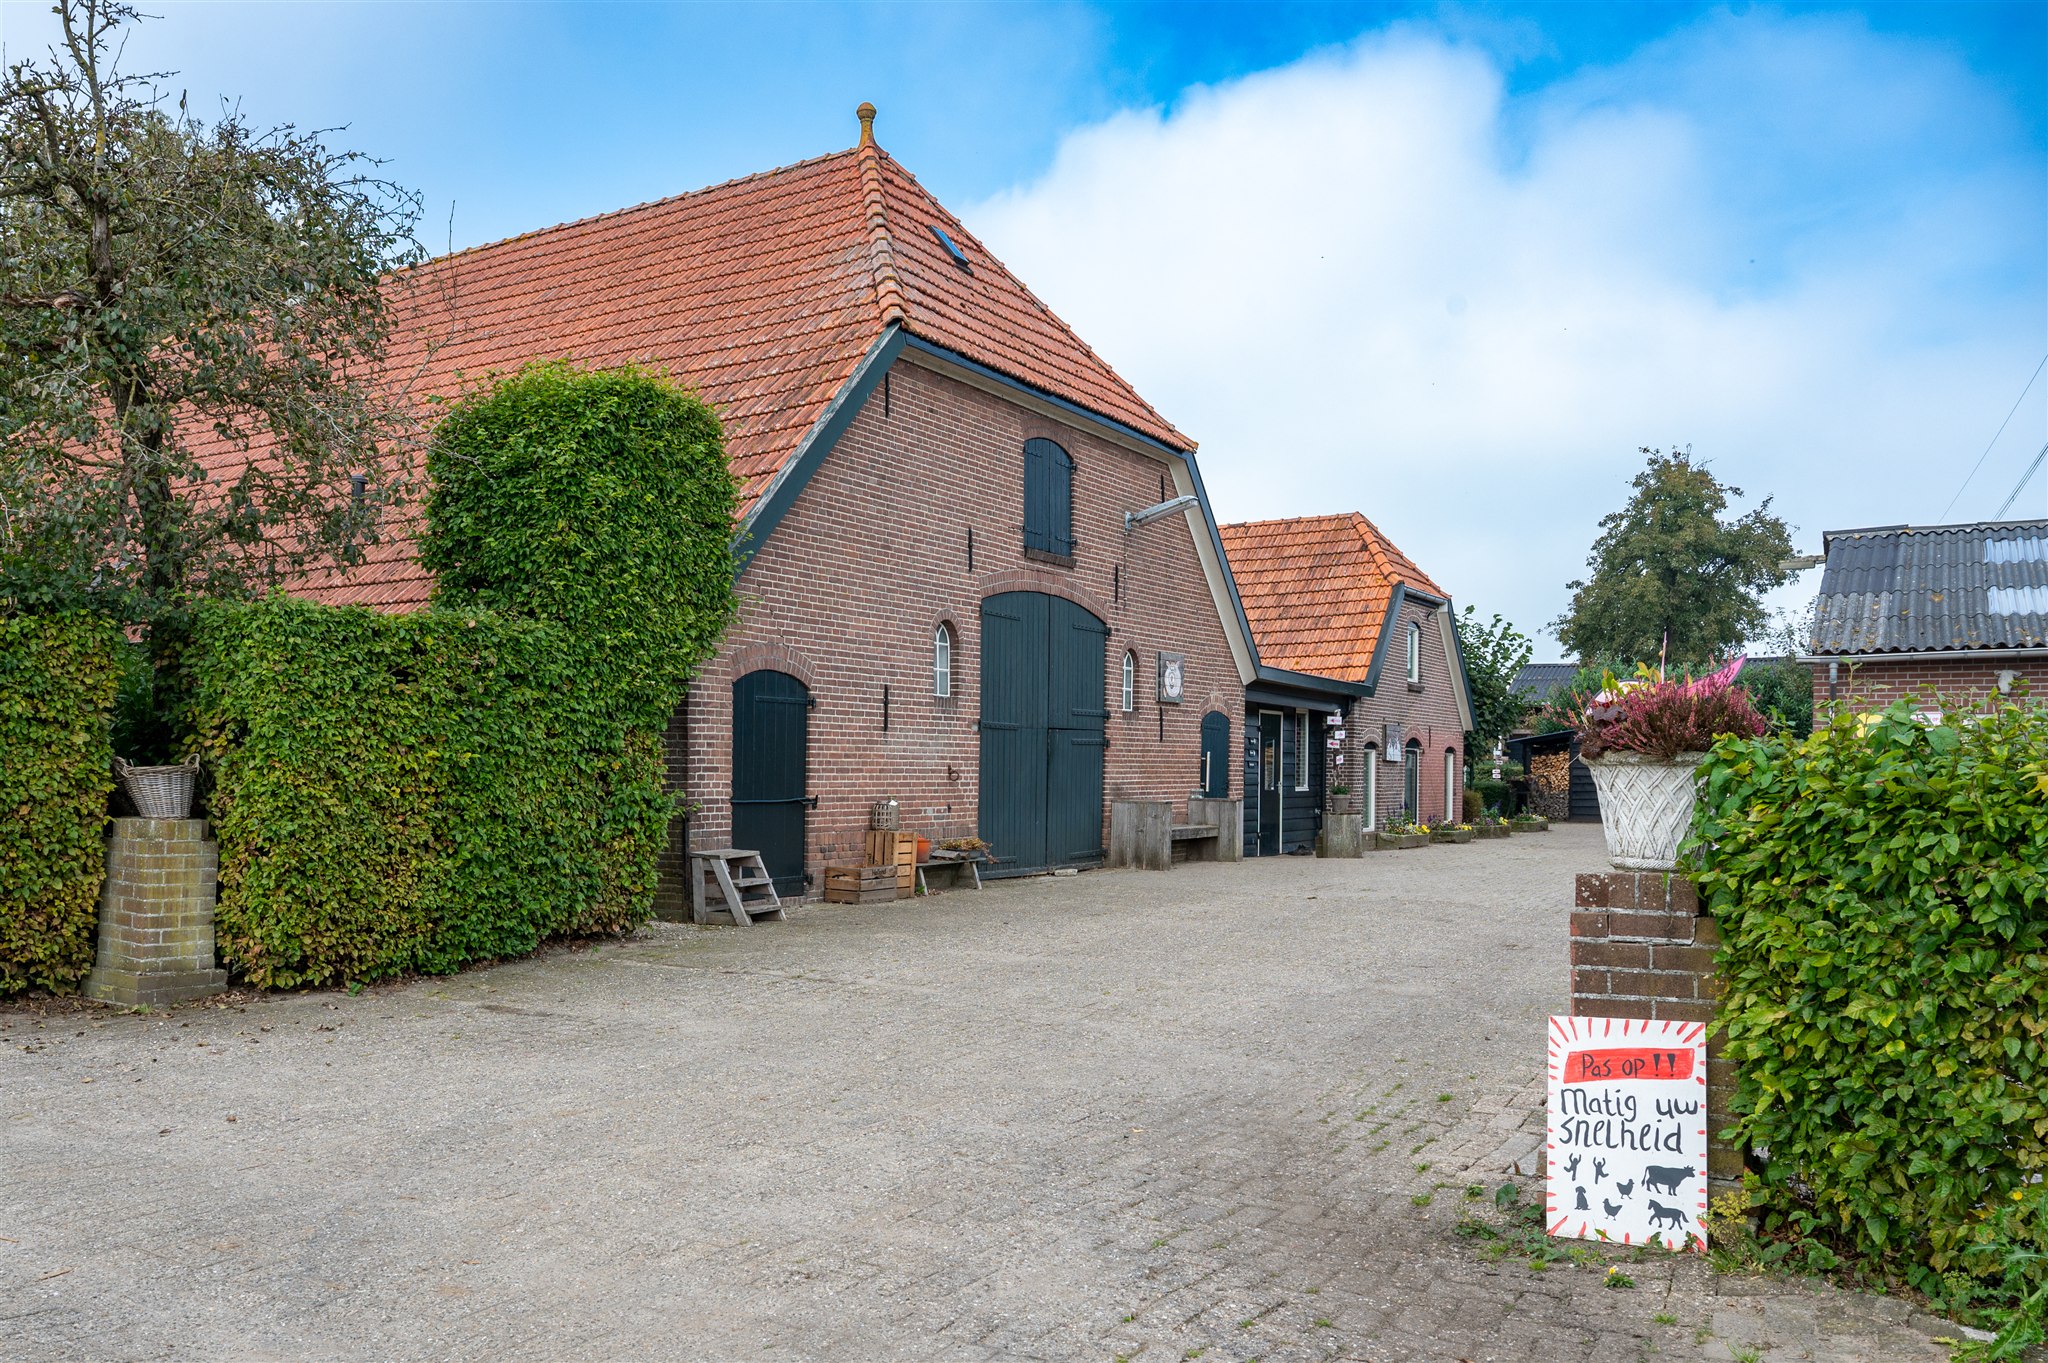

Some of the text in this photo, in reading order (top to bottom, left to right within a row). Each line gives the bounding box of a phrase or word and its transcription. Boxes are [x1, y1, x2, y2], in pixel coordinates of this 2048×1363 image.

[1581, 1053, 1611, 1079] Pas
[1560, 1088, 1698, 1122] Matig uw
